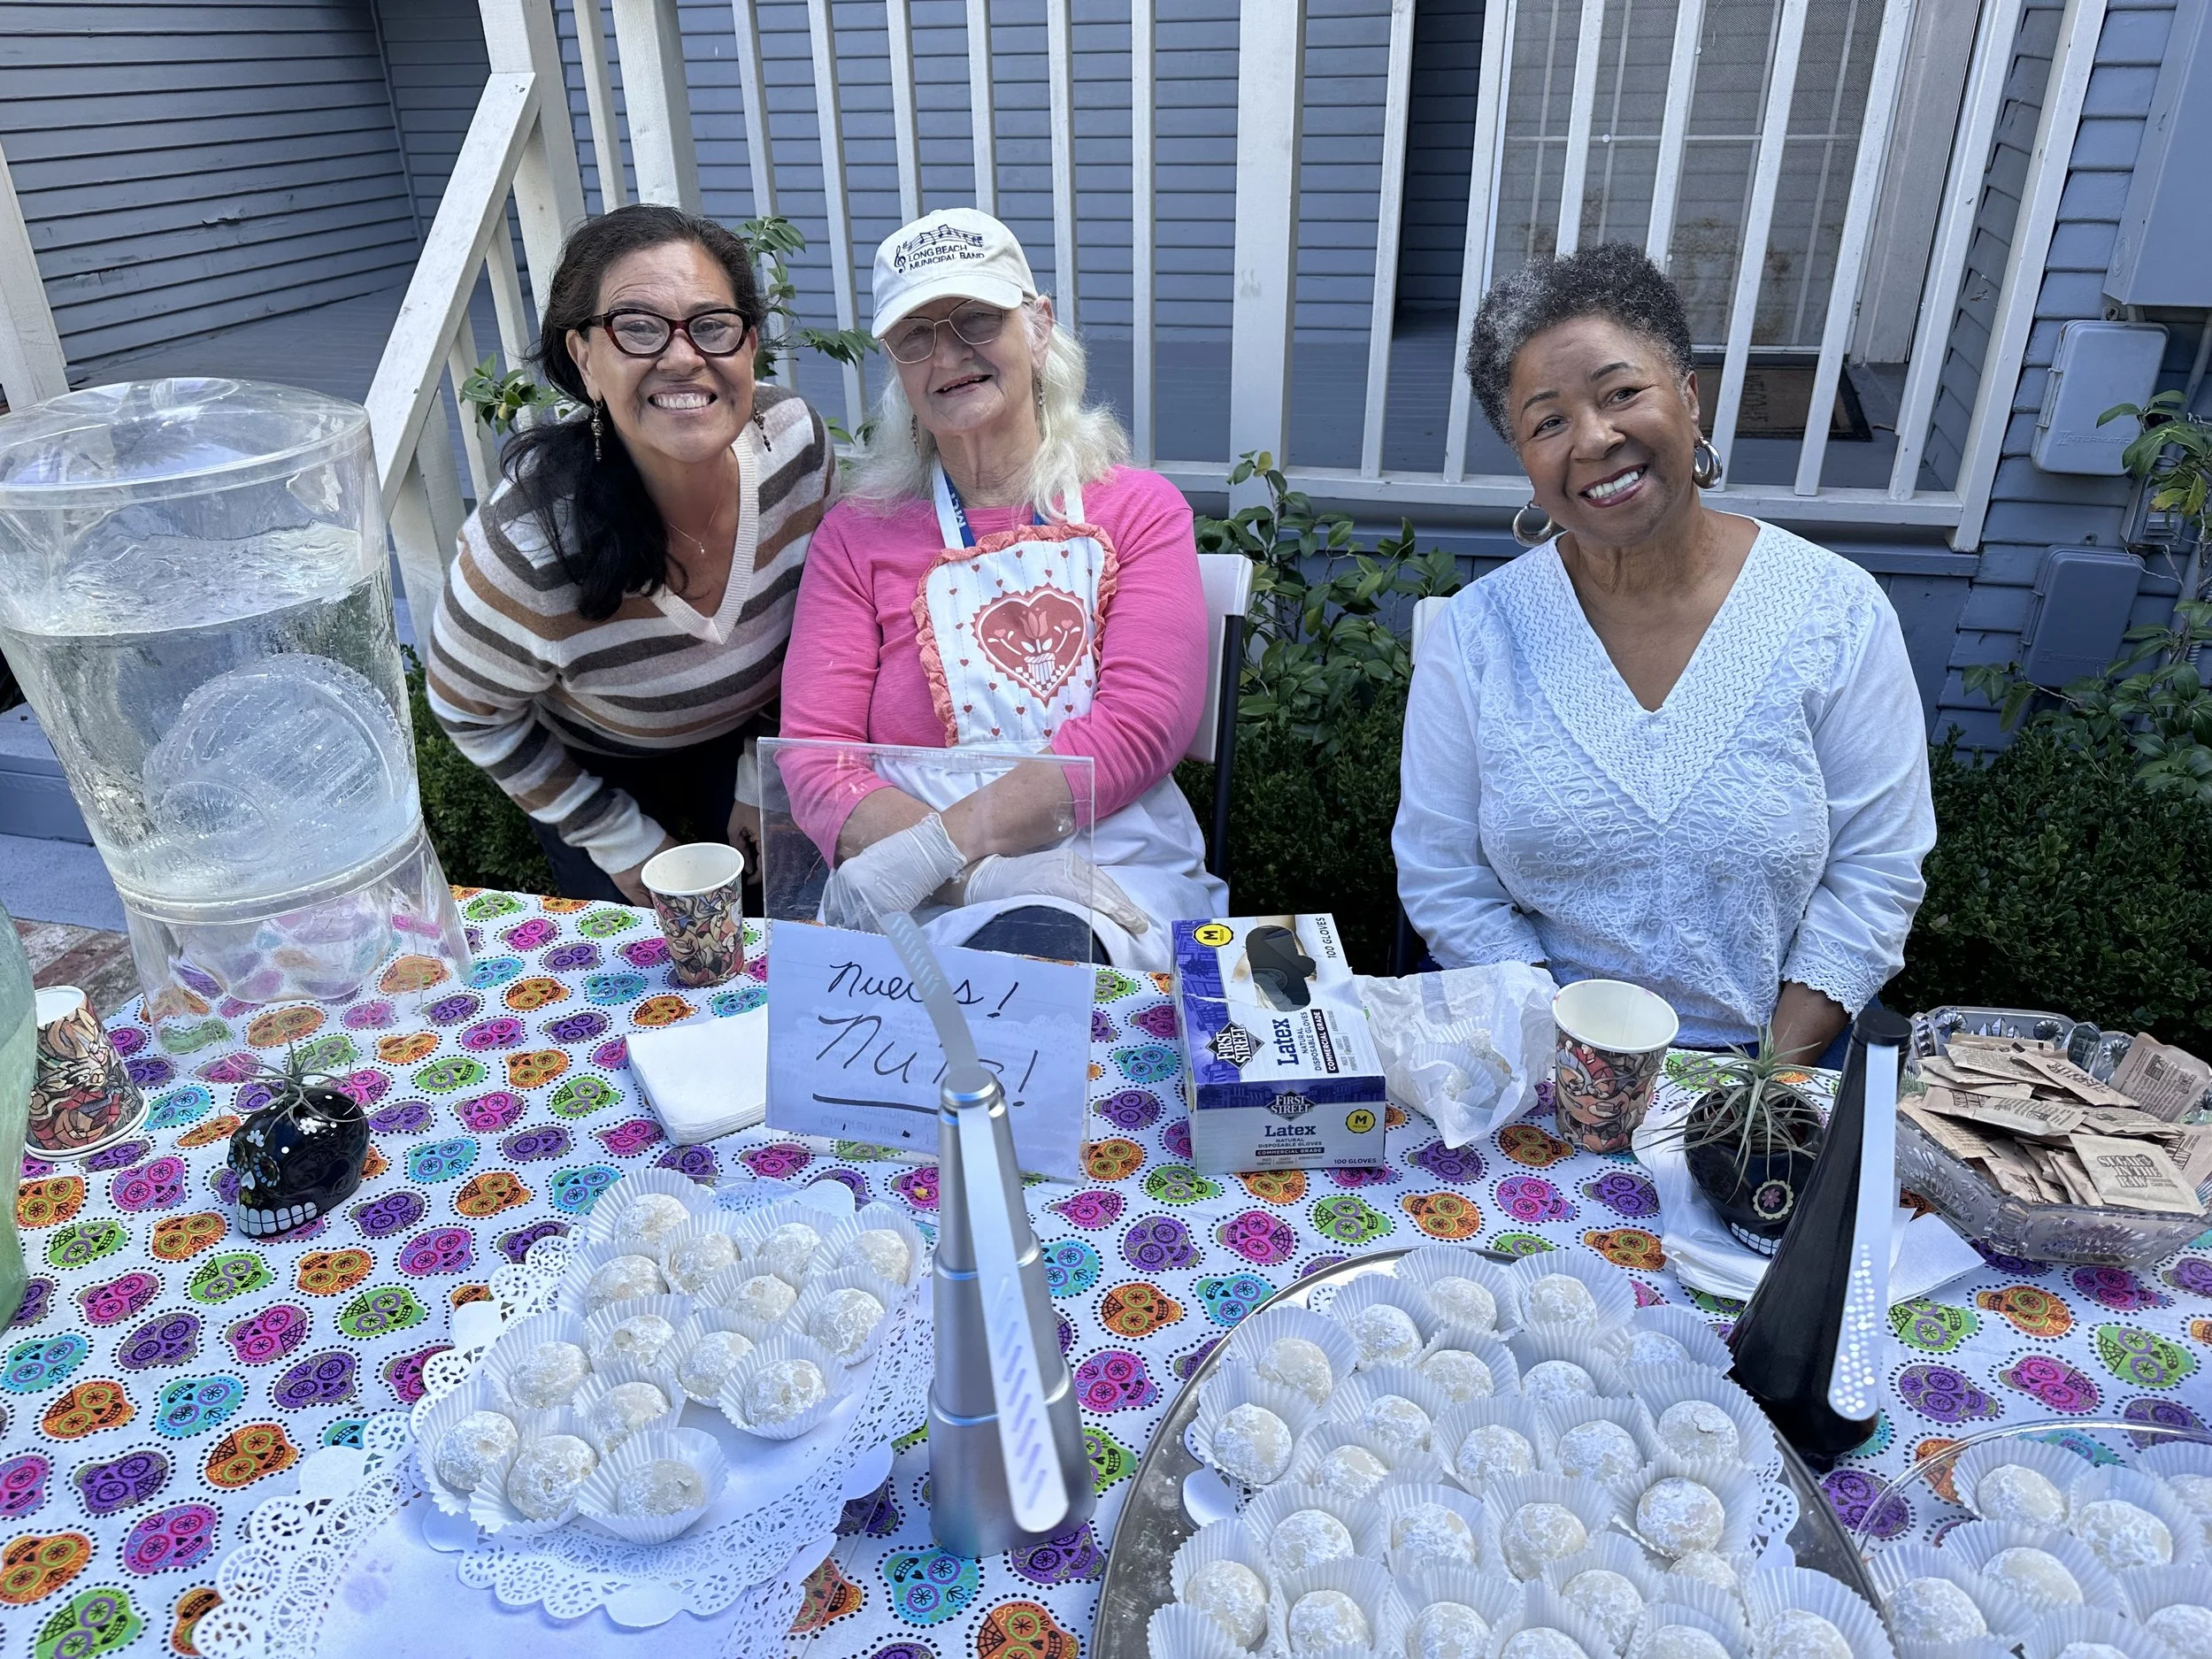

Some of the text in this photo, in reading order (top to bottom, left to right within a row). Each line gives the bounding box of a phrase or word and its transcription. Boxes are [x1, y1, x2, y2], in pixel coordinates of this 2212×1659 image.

[909, 244, 968, 262] LONG BEACH
[910, 254, 956, 271] MUNICIPAL
[1203, 930, 1218, 941] M
[1316, 917, 1337, 958] 100 GLOVES
[827, 961, 1018, 1018] Nuecs!
[1313, 1011, 1325, 1031] GRADE
[1216, 1032, 1235, 1061] FIRST
[1231, 1026, 1253, 1064] STREET
[1272, 1018, 1300, 1065] Latex
[1296, 1027, 1309, 1054] NATURAL
[1301, 1011, 1322, 1071] DISPOSABLE GLOVES
[1319, 1032, 1336, 1071] COMMERCIAL
[1271, 1103, 1310, 1114] STREET
[1275, 1094, 1307, 1105] FIRST
[1355, 1115, 1368, 1125] M
[1264, 1125, 1317, 1137] Latex
[2097, 1155, 2147, 1167] SUGAR
[2112, 1165, 2162, 1178] IN THE
[2116, 1175, 2148, 1187] RAW
